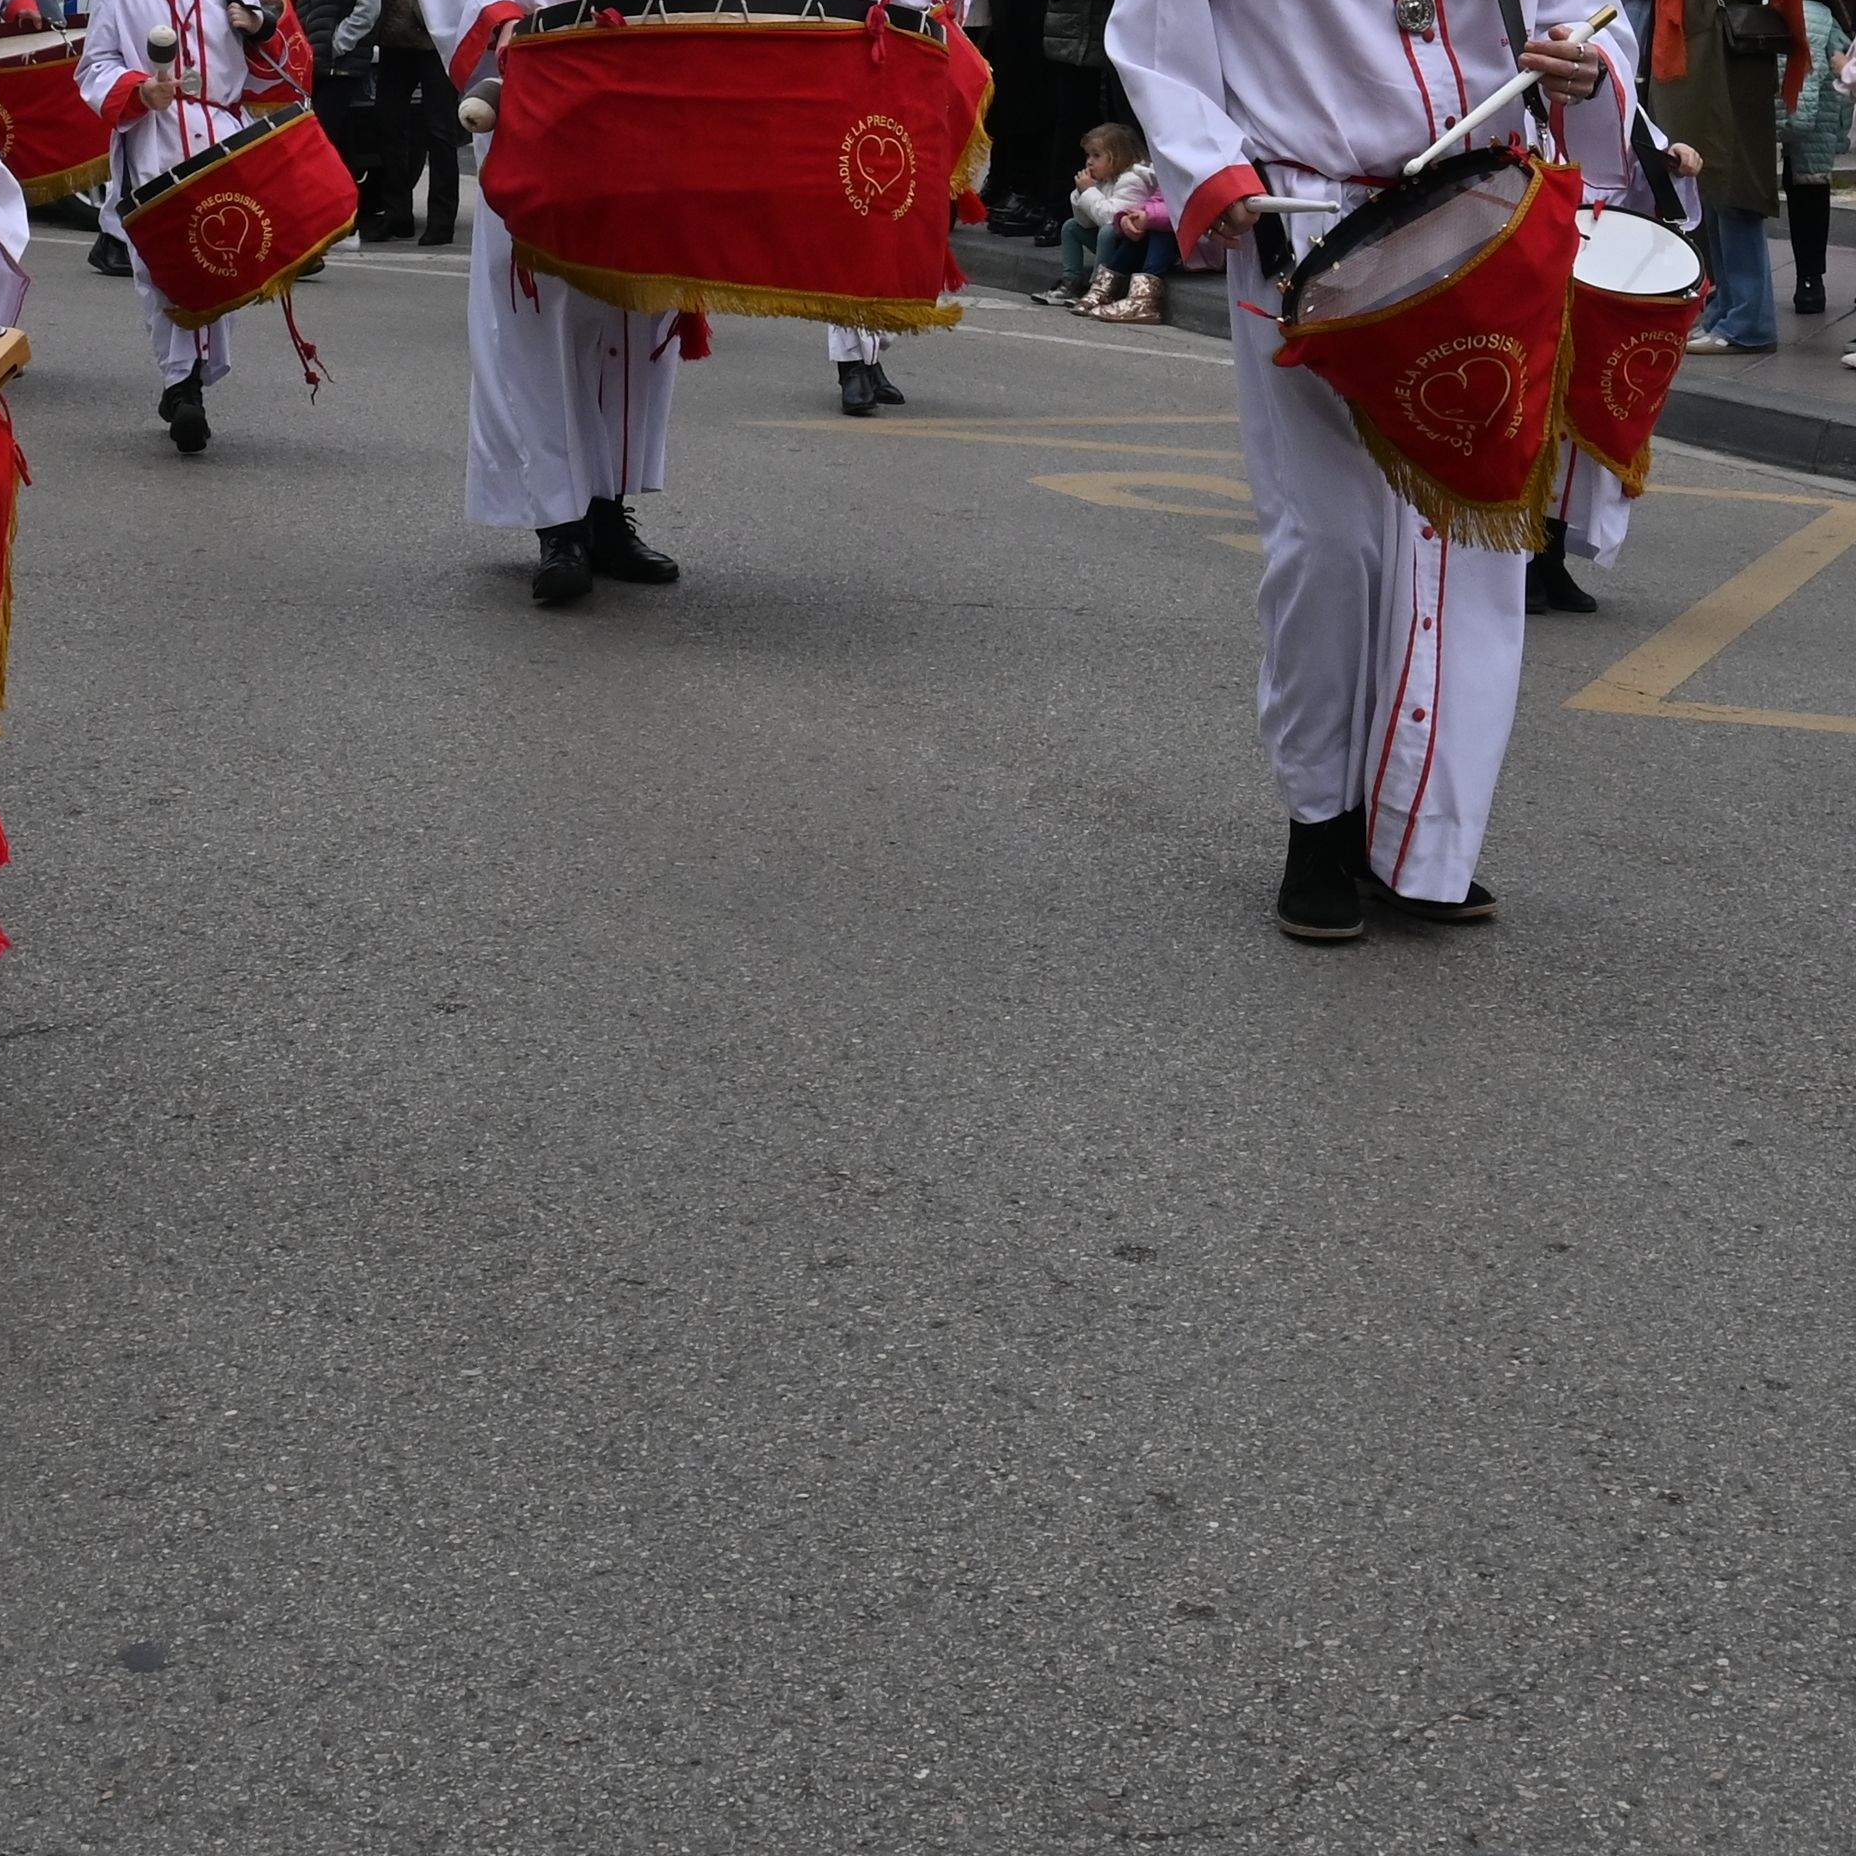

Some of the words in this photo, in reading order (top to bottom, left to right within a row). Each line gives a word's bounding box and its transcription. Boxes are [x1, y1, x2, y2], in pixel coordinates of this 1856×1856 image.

[841, 132, 855, 152] DE
[850, 119, 867, 136] LA
[1606, 349, 1623, 366] DE
[1620, 335, 1639, 350] LA
[1396, 370, 1422, 385] LA
